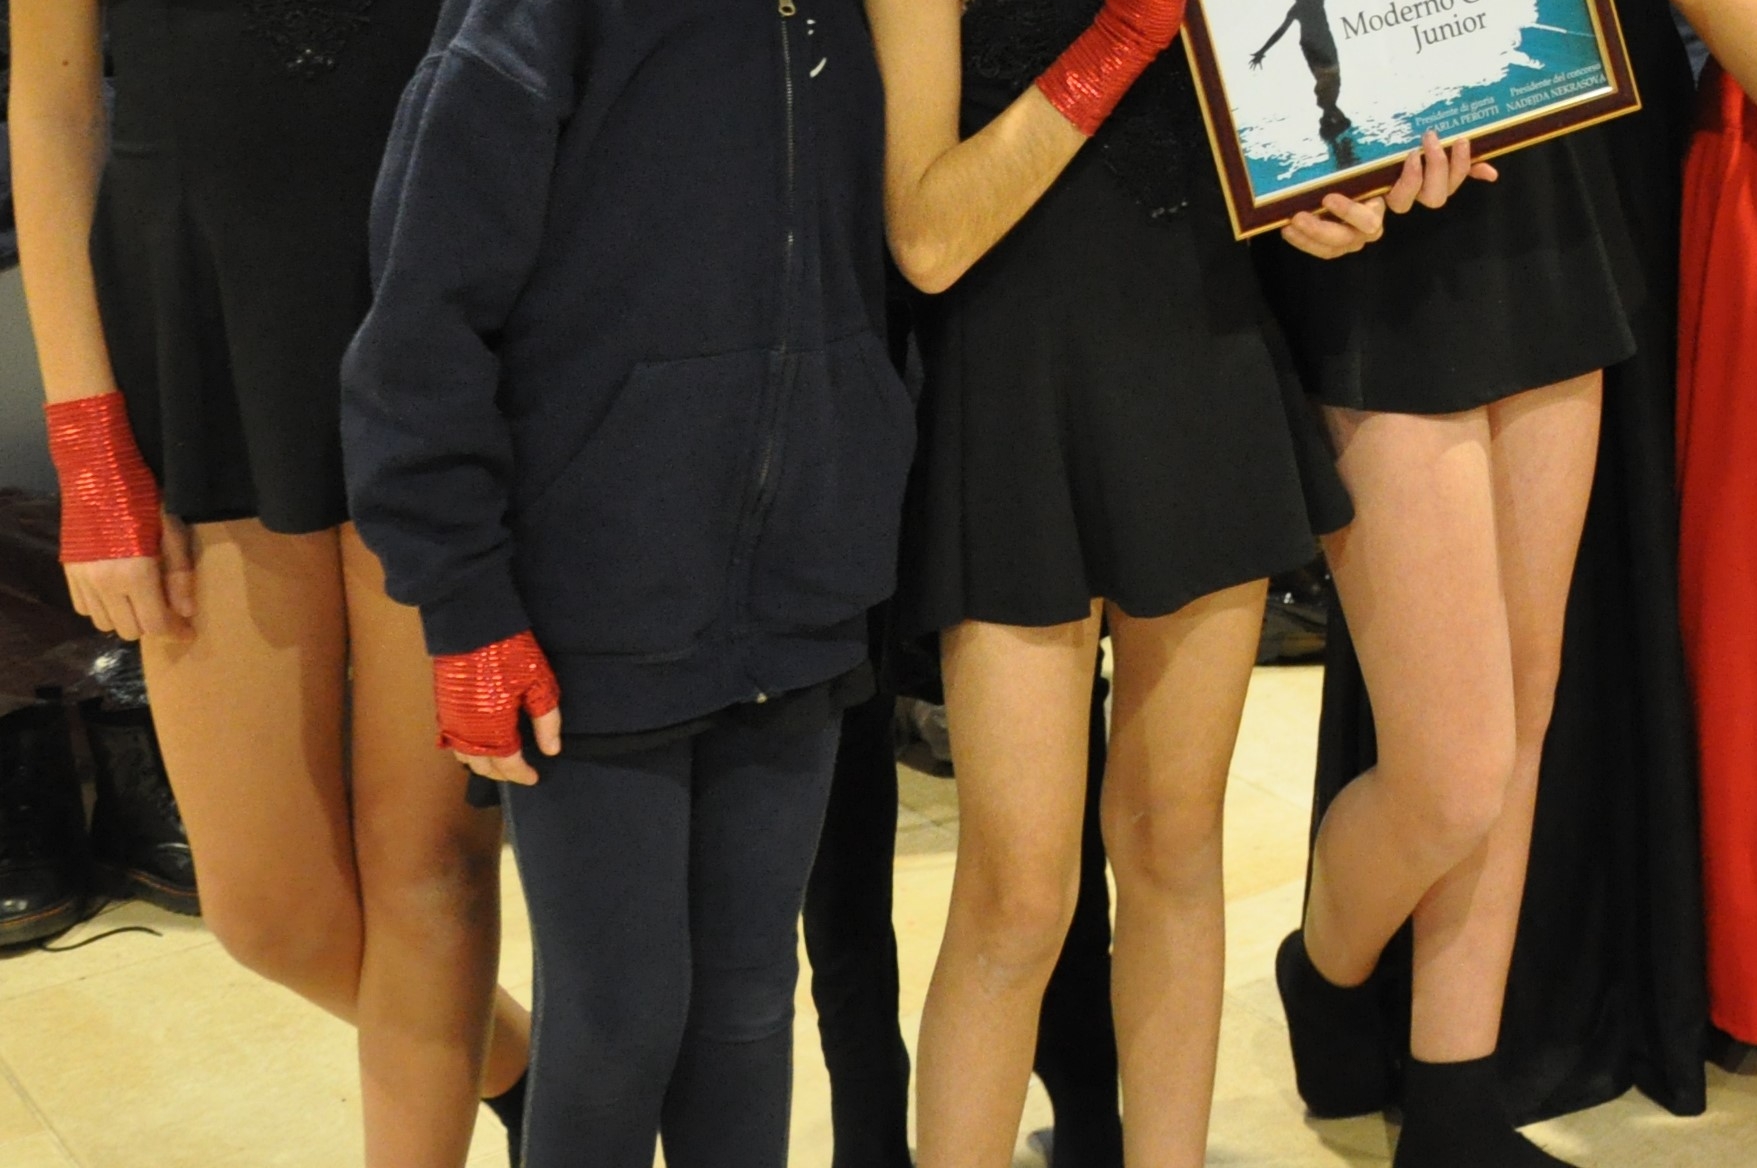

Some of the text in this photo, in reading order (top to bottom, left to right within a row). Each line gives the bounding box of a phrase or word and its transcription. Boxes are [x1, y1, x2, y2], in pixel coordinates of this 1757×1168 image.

[1411, 12, 1487, 54] Junior
[1509, 80, 1551, 97] Presidente
[1552, 73, 1566, 85] del
[1415, 108, 1459, 126] Presidente
[1460, 103, 1469, 113] di
[1460, 105, 1500, 125] PEROTTI
